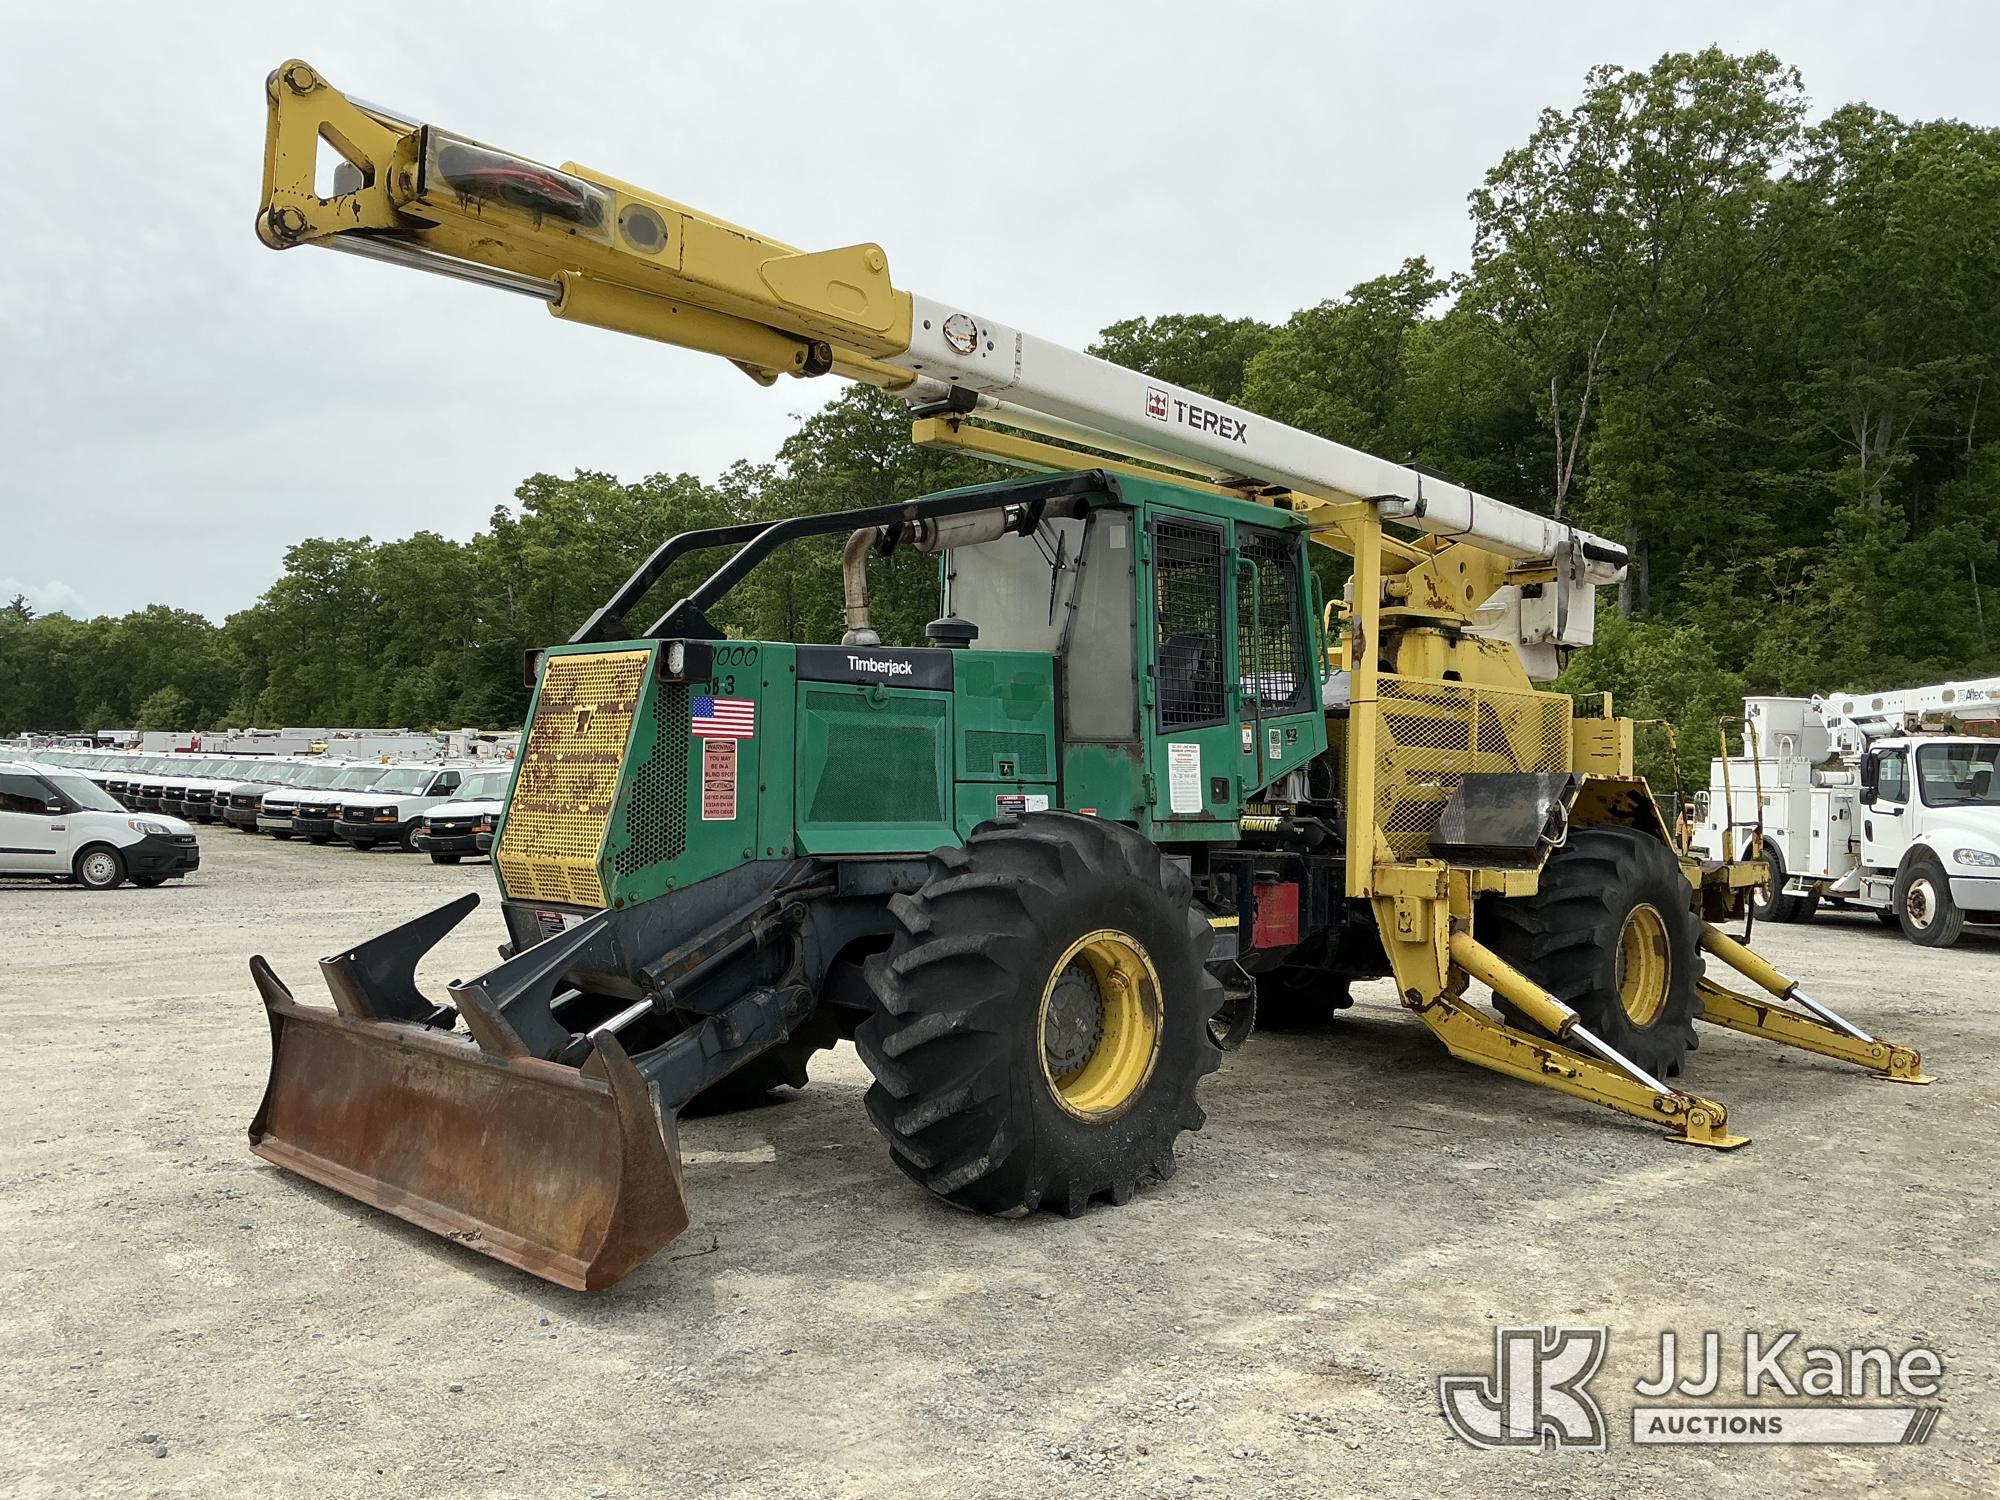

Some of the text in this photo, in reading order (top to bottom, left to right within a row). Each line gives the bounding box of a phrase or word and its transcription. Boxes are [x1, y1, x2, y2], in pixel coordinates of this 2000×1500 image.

[1173, 398, 1248, 445] TEREX
[712, 646, 758, 666] 000
[846, 655, 912, 677] Timberjack
[1965, 688, 1984, 701] Altec
[1240, 819, 1279, 832] EUMATIC
